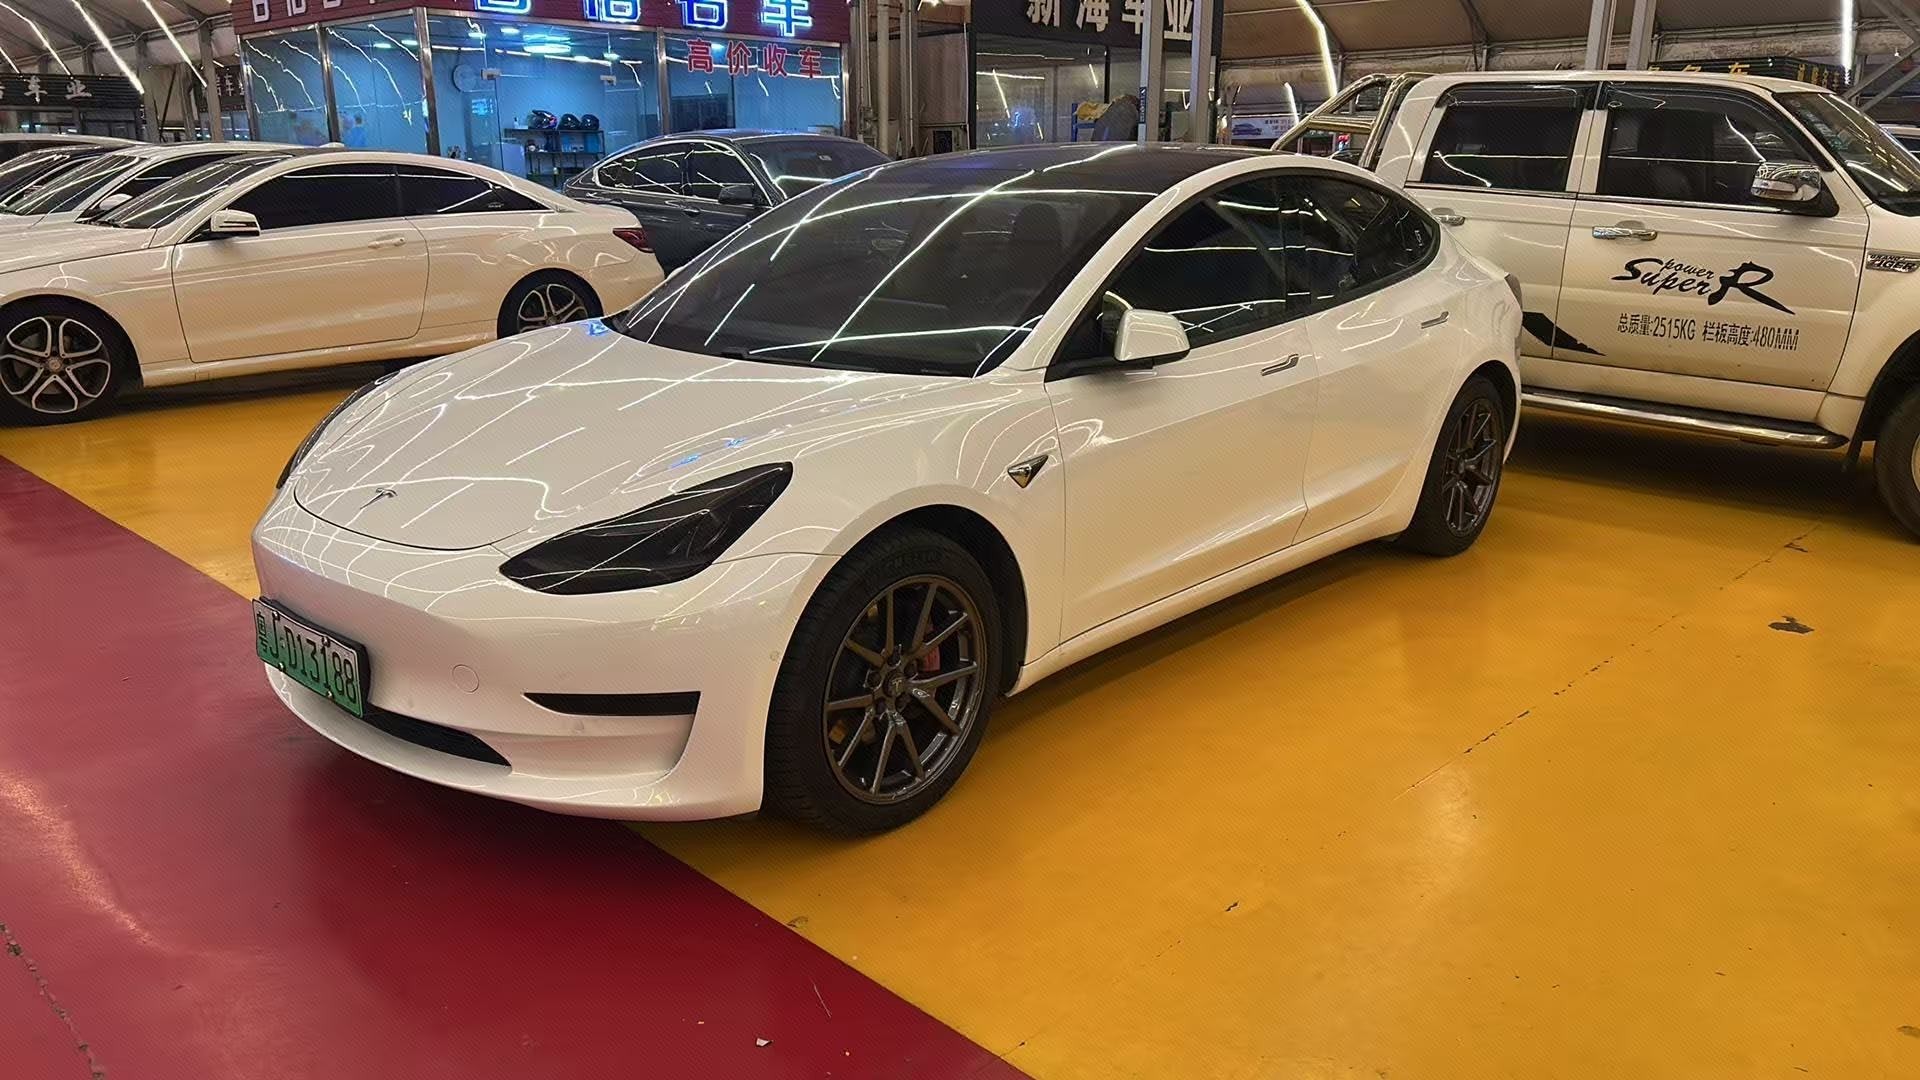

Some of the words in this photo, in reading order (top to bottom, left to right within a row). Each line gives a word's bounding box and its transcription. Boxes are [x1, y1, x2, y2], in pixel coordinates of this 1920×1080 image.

[686, 38, 822, 79] 高价收车
[0, 75, 92, 104] 车业
[1660, 258, 1714, 280] power
